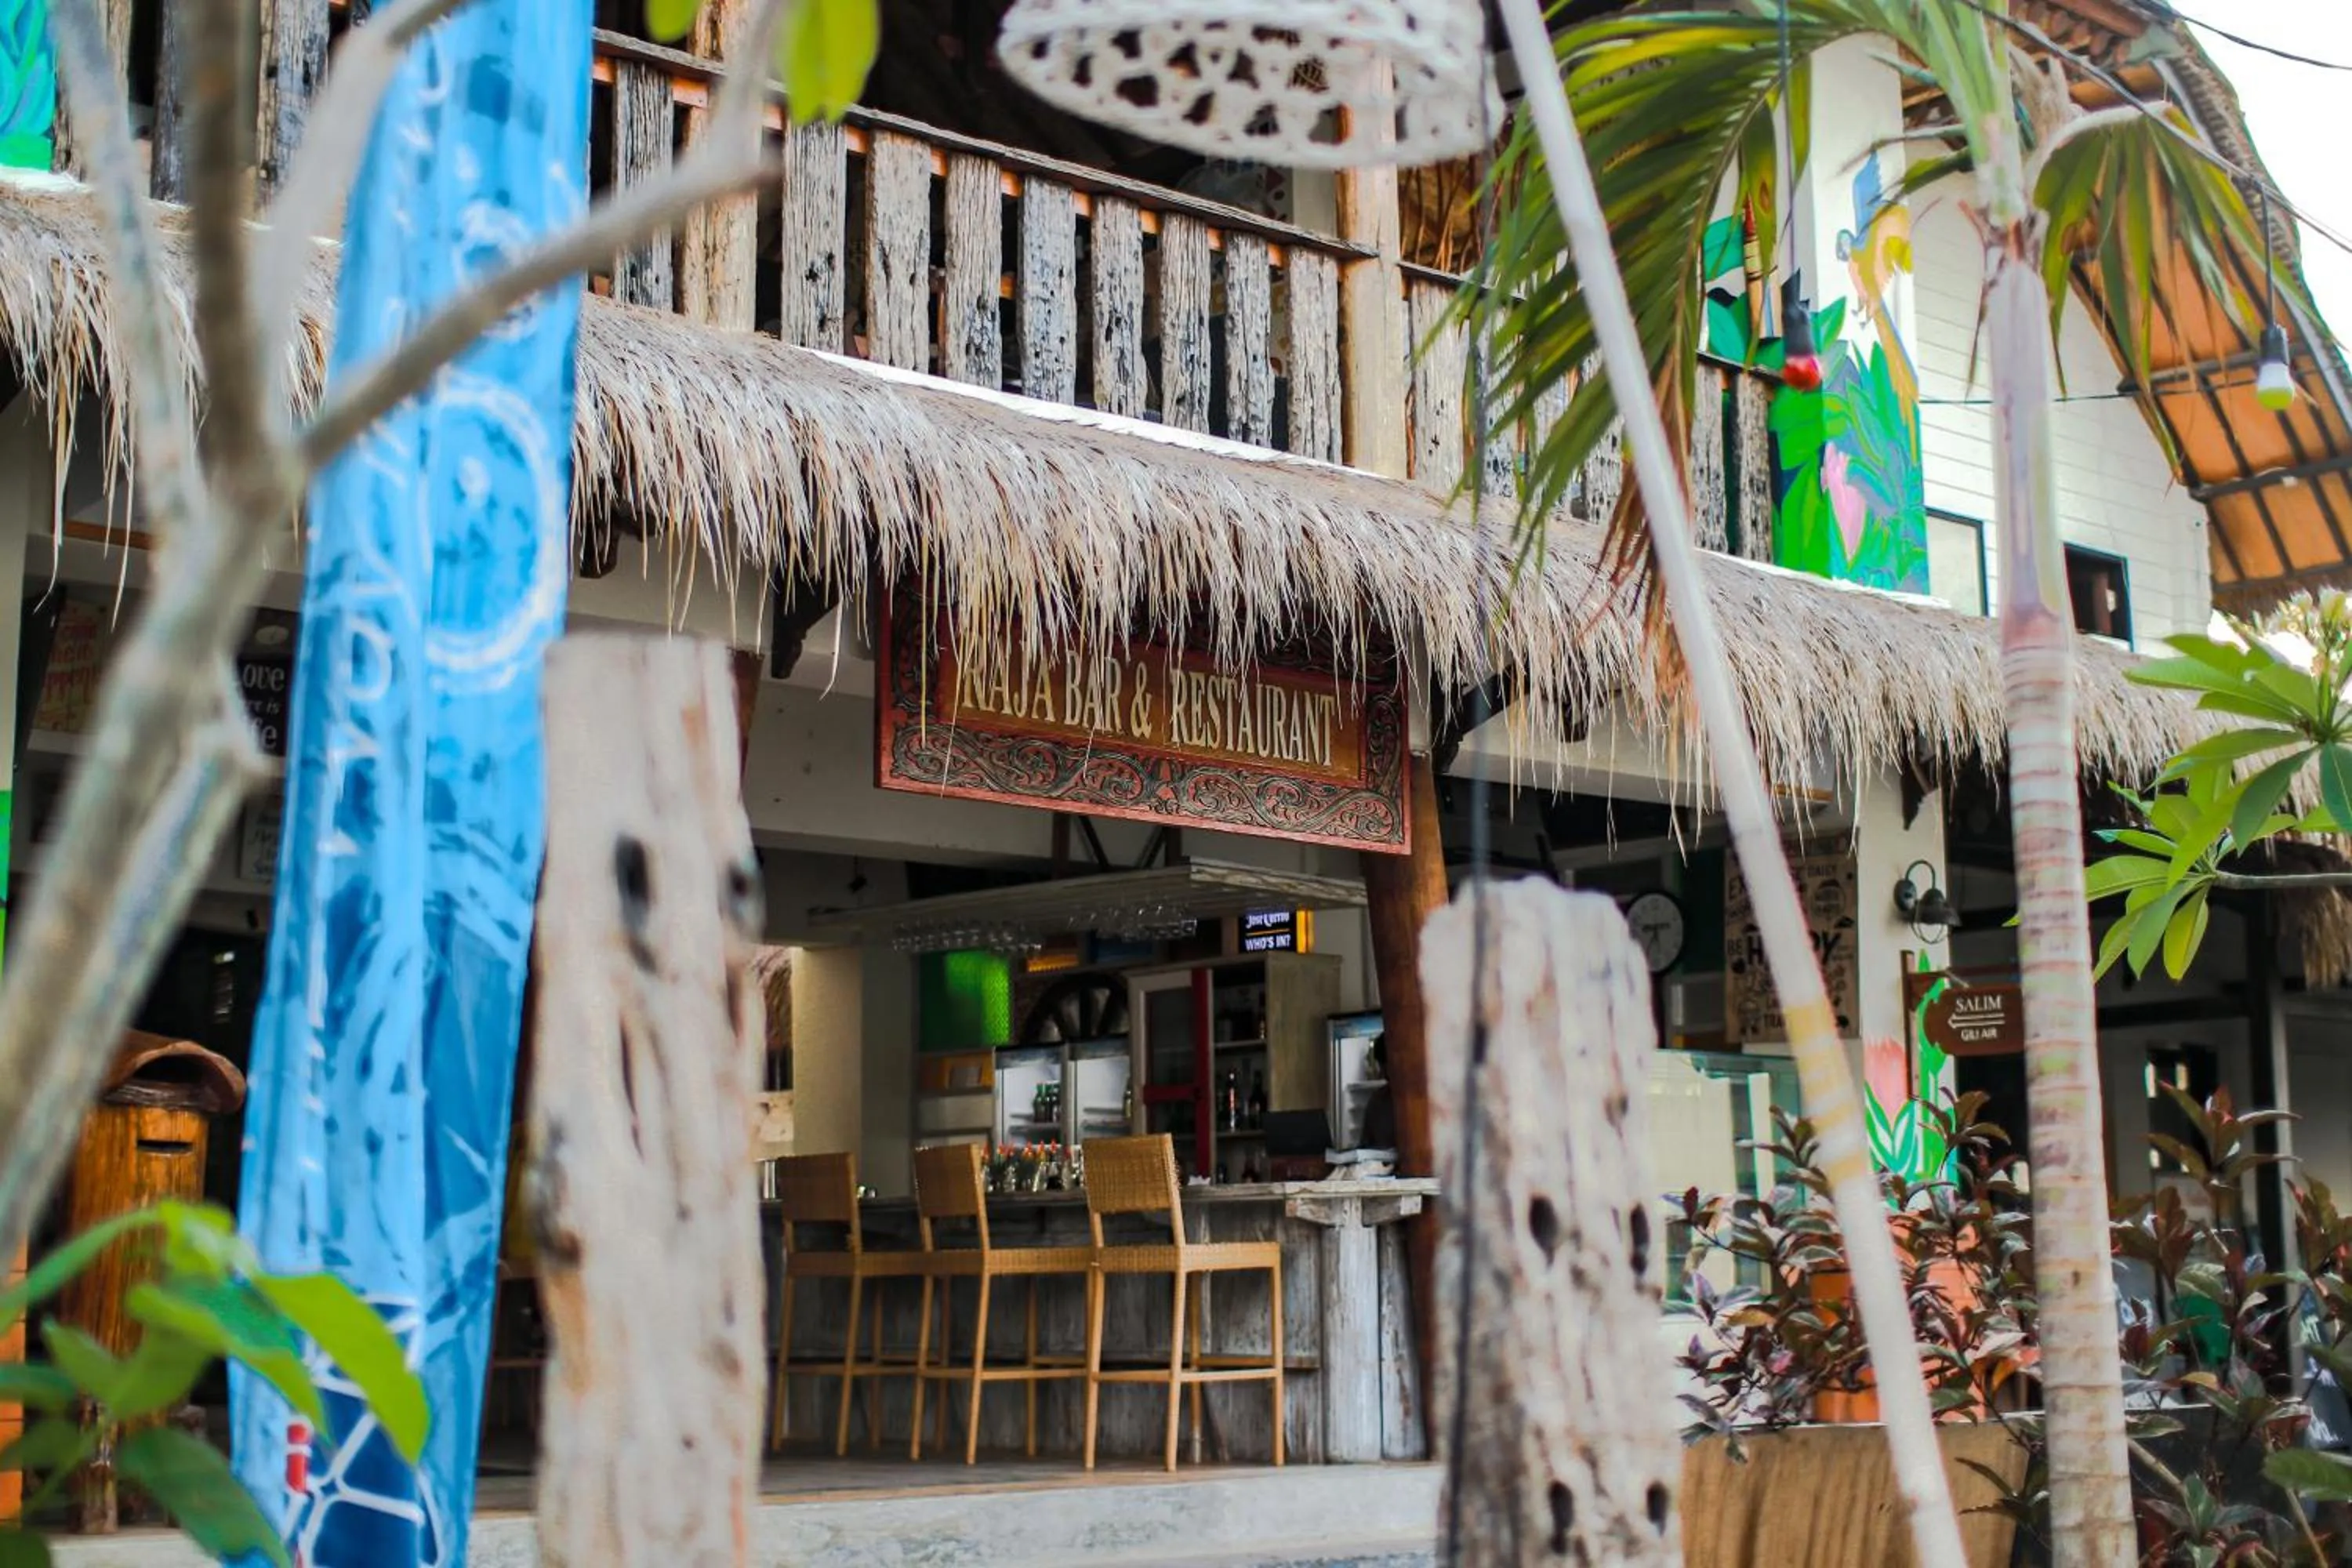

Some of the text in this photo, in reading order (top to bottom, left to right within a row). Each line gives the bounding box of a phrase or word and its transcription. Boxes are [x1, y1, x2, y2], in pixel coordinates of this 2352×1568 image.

[243, 664, 285, 692] ove
[1064, 650, 1123, 734] BAR
[1130, 661, 1153, 739] &
[1170, 668, 1335, 766] RESTAURANT
[1245, 935, 1290, 951] WHO'S IN?
[1955, 995, 2002, 1013] SALIM
